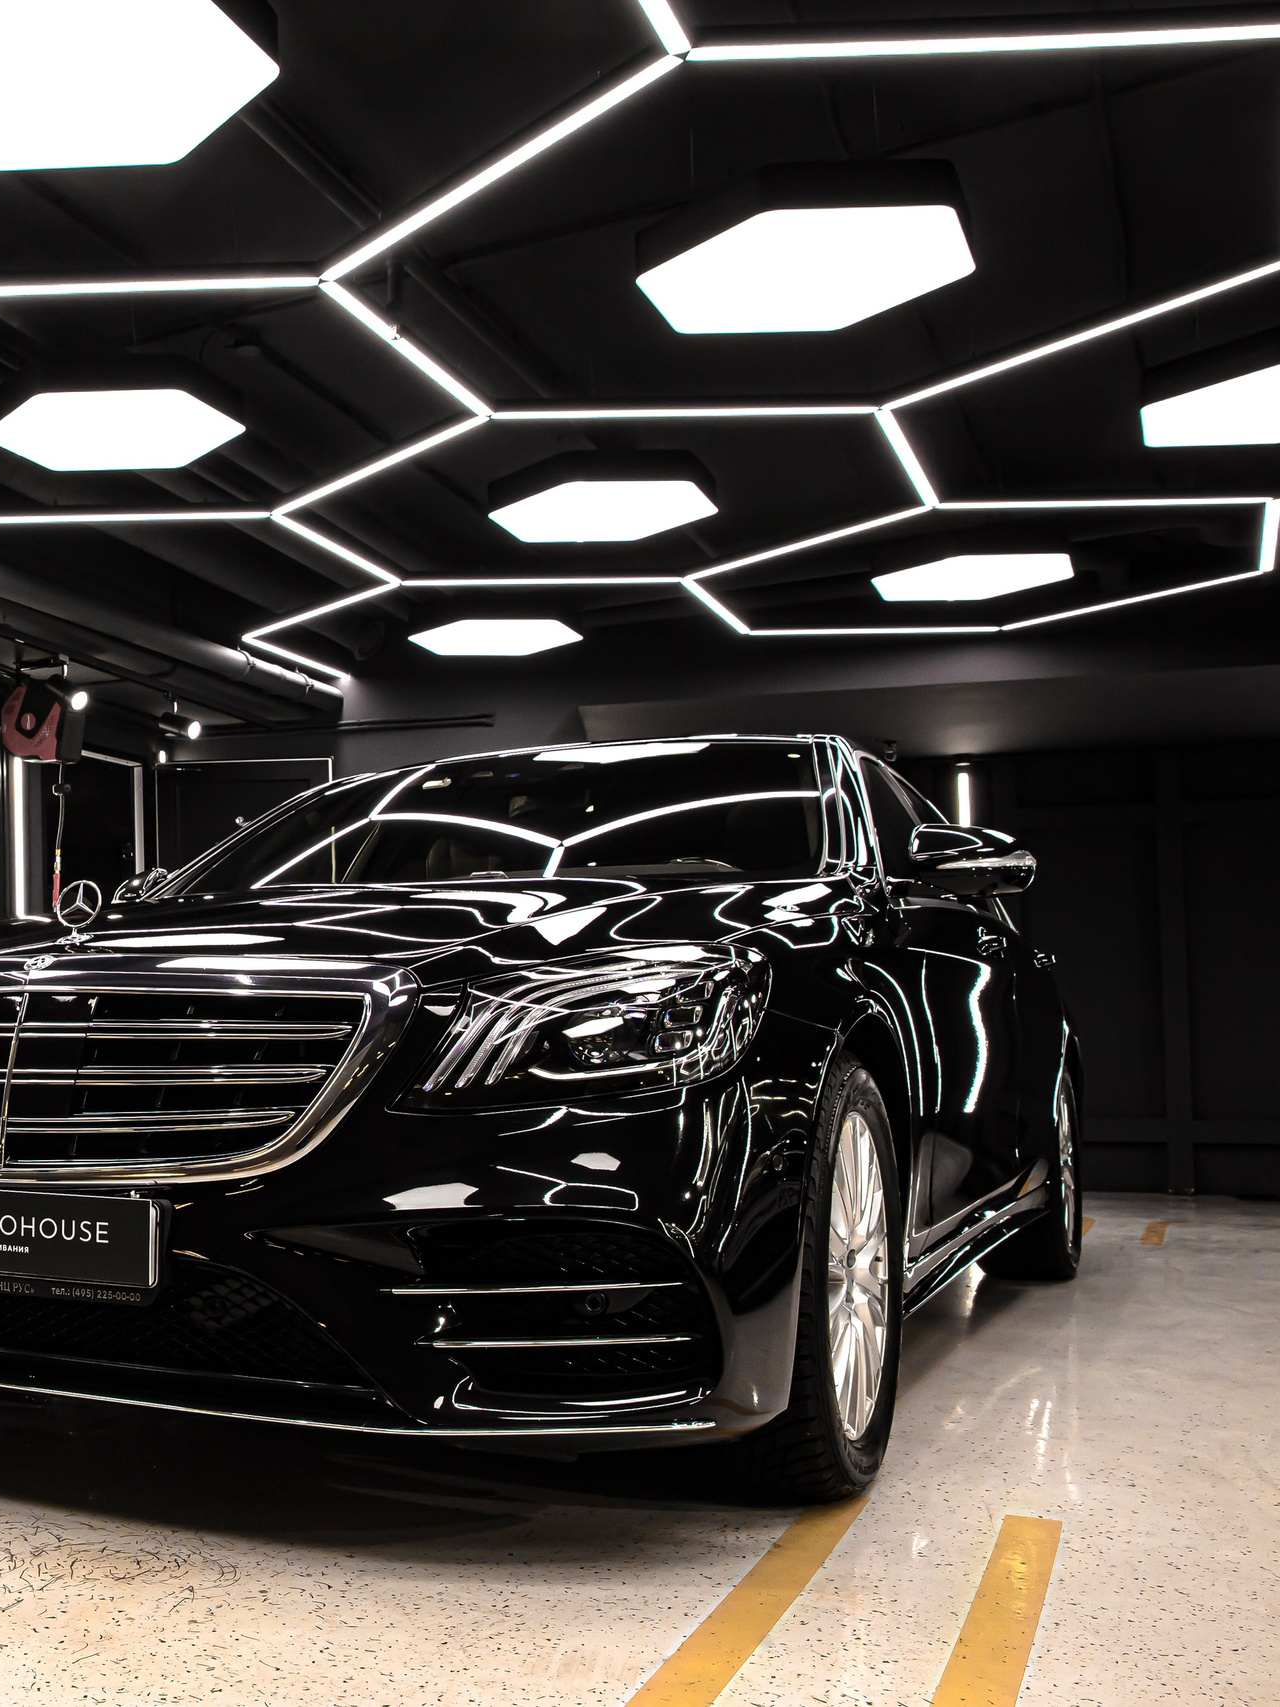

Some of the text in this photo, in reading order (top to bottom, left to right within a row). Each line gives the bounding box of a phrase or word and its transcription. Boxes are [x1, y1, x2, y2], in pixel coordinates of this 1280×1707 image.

[13, 1282, 35, 1294] РУС»
[51, 1286, 141, 1302] тел.: (495) 225-00-00
